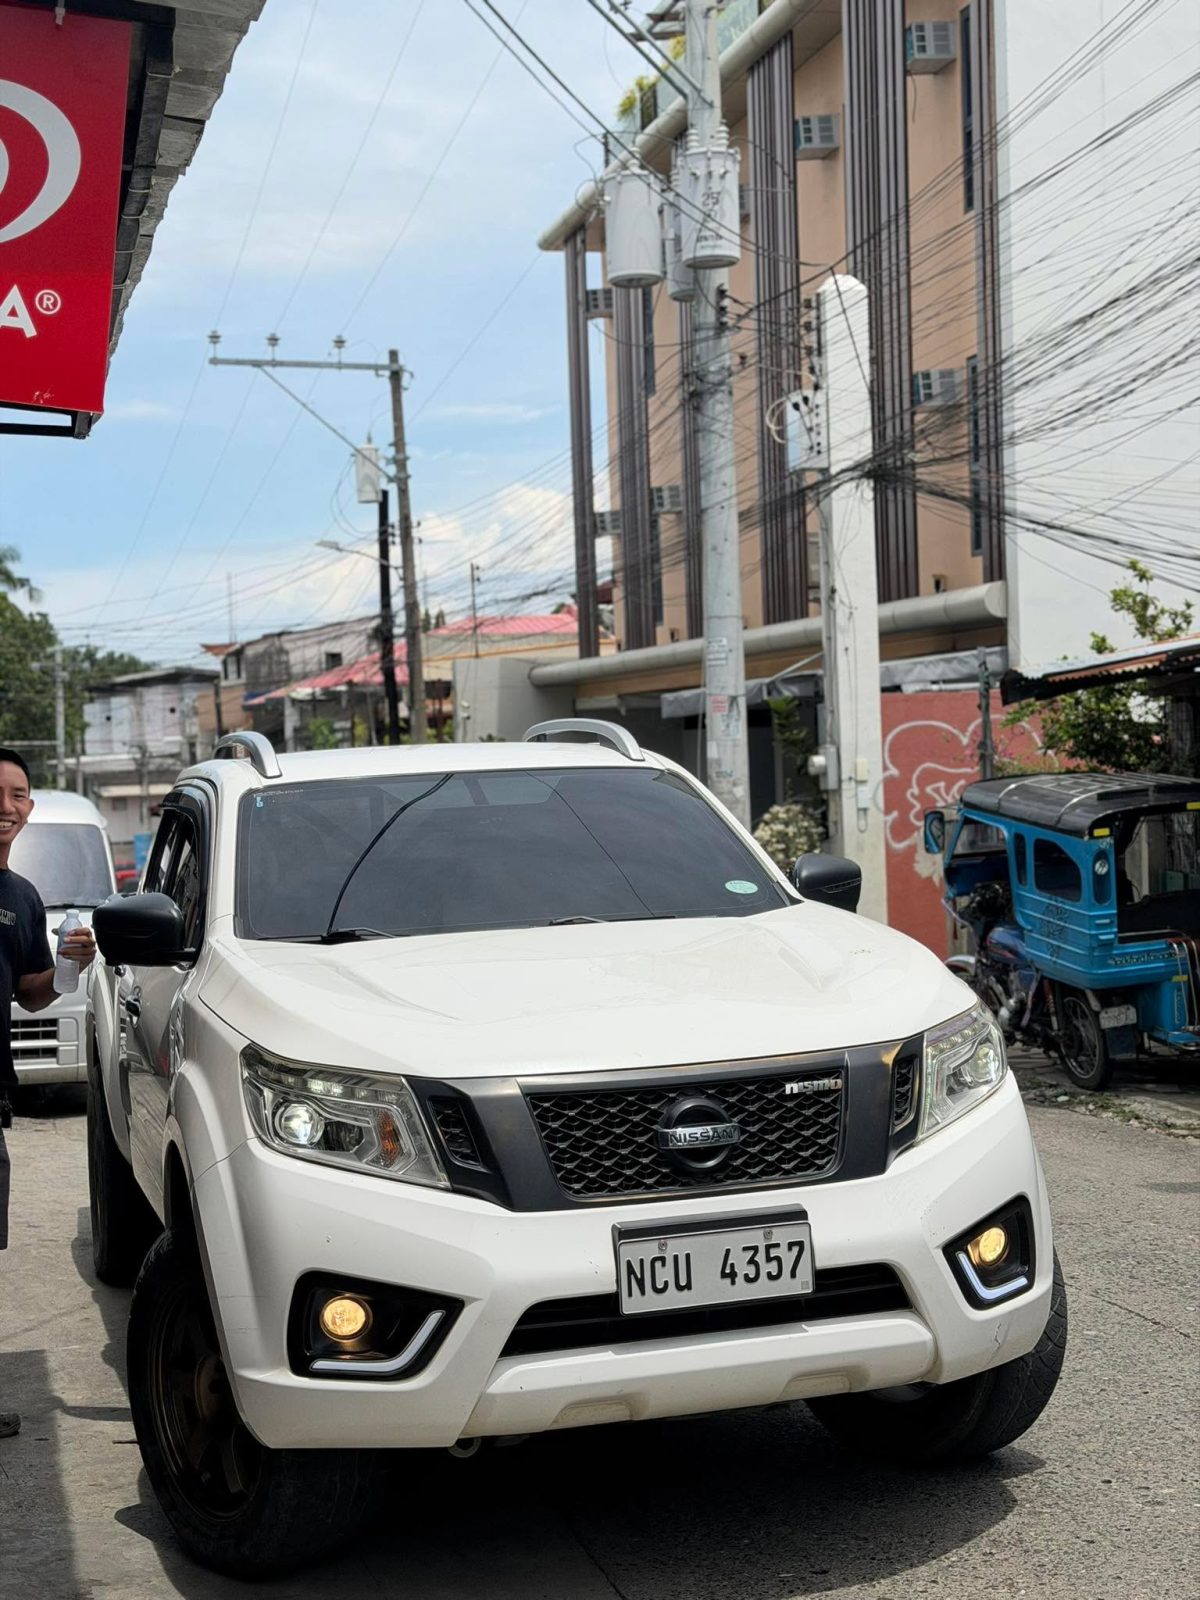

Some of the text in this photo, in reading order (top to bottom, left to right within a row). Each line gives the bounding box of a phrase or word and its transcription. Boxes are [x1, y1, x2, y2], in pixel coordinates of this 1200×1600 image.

[668, 1127, 735, 1146] NISSAN
[626, 1240, 805, 1298] NCU 4357
